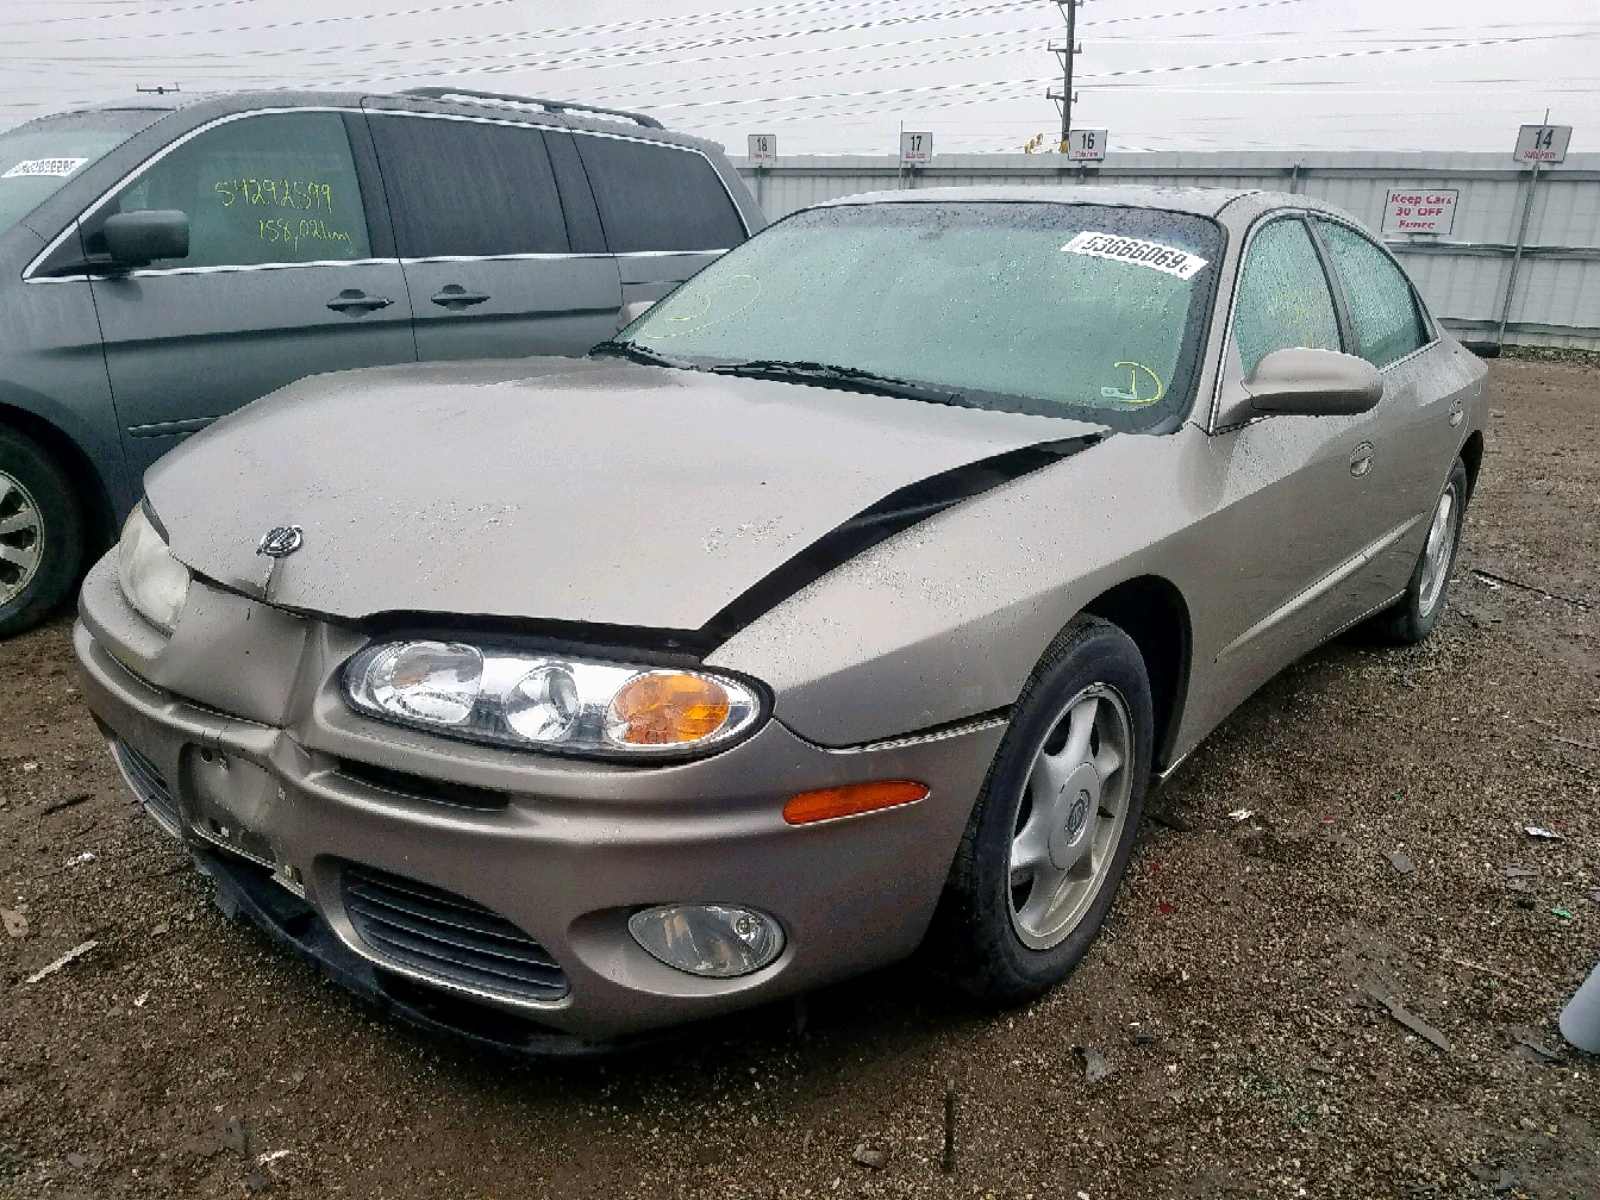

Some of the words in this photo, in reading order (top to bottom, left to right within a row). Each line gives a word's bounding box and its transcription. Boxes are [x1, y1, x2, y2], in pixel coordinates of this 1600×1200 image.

[757, 136, 767, 151] 18
[910, 134, 922, 151] 17
[1081, 132, 1095, 149] 16
[1535, 129, 1554, 149] 14
[214, 178, 332, 214] 54292599
[1390, 193, 1422, 206] Keep
[1425, 193, 1453, 205] Cars
[1417, 207, 1443, 216] OFF
[1398, 219, 1436, 229] Fence
[1081, 235, 1188, 269] 53666069
